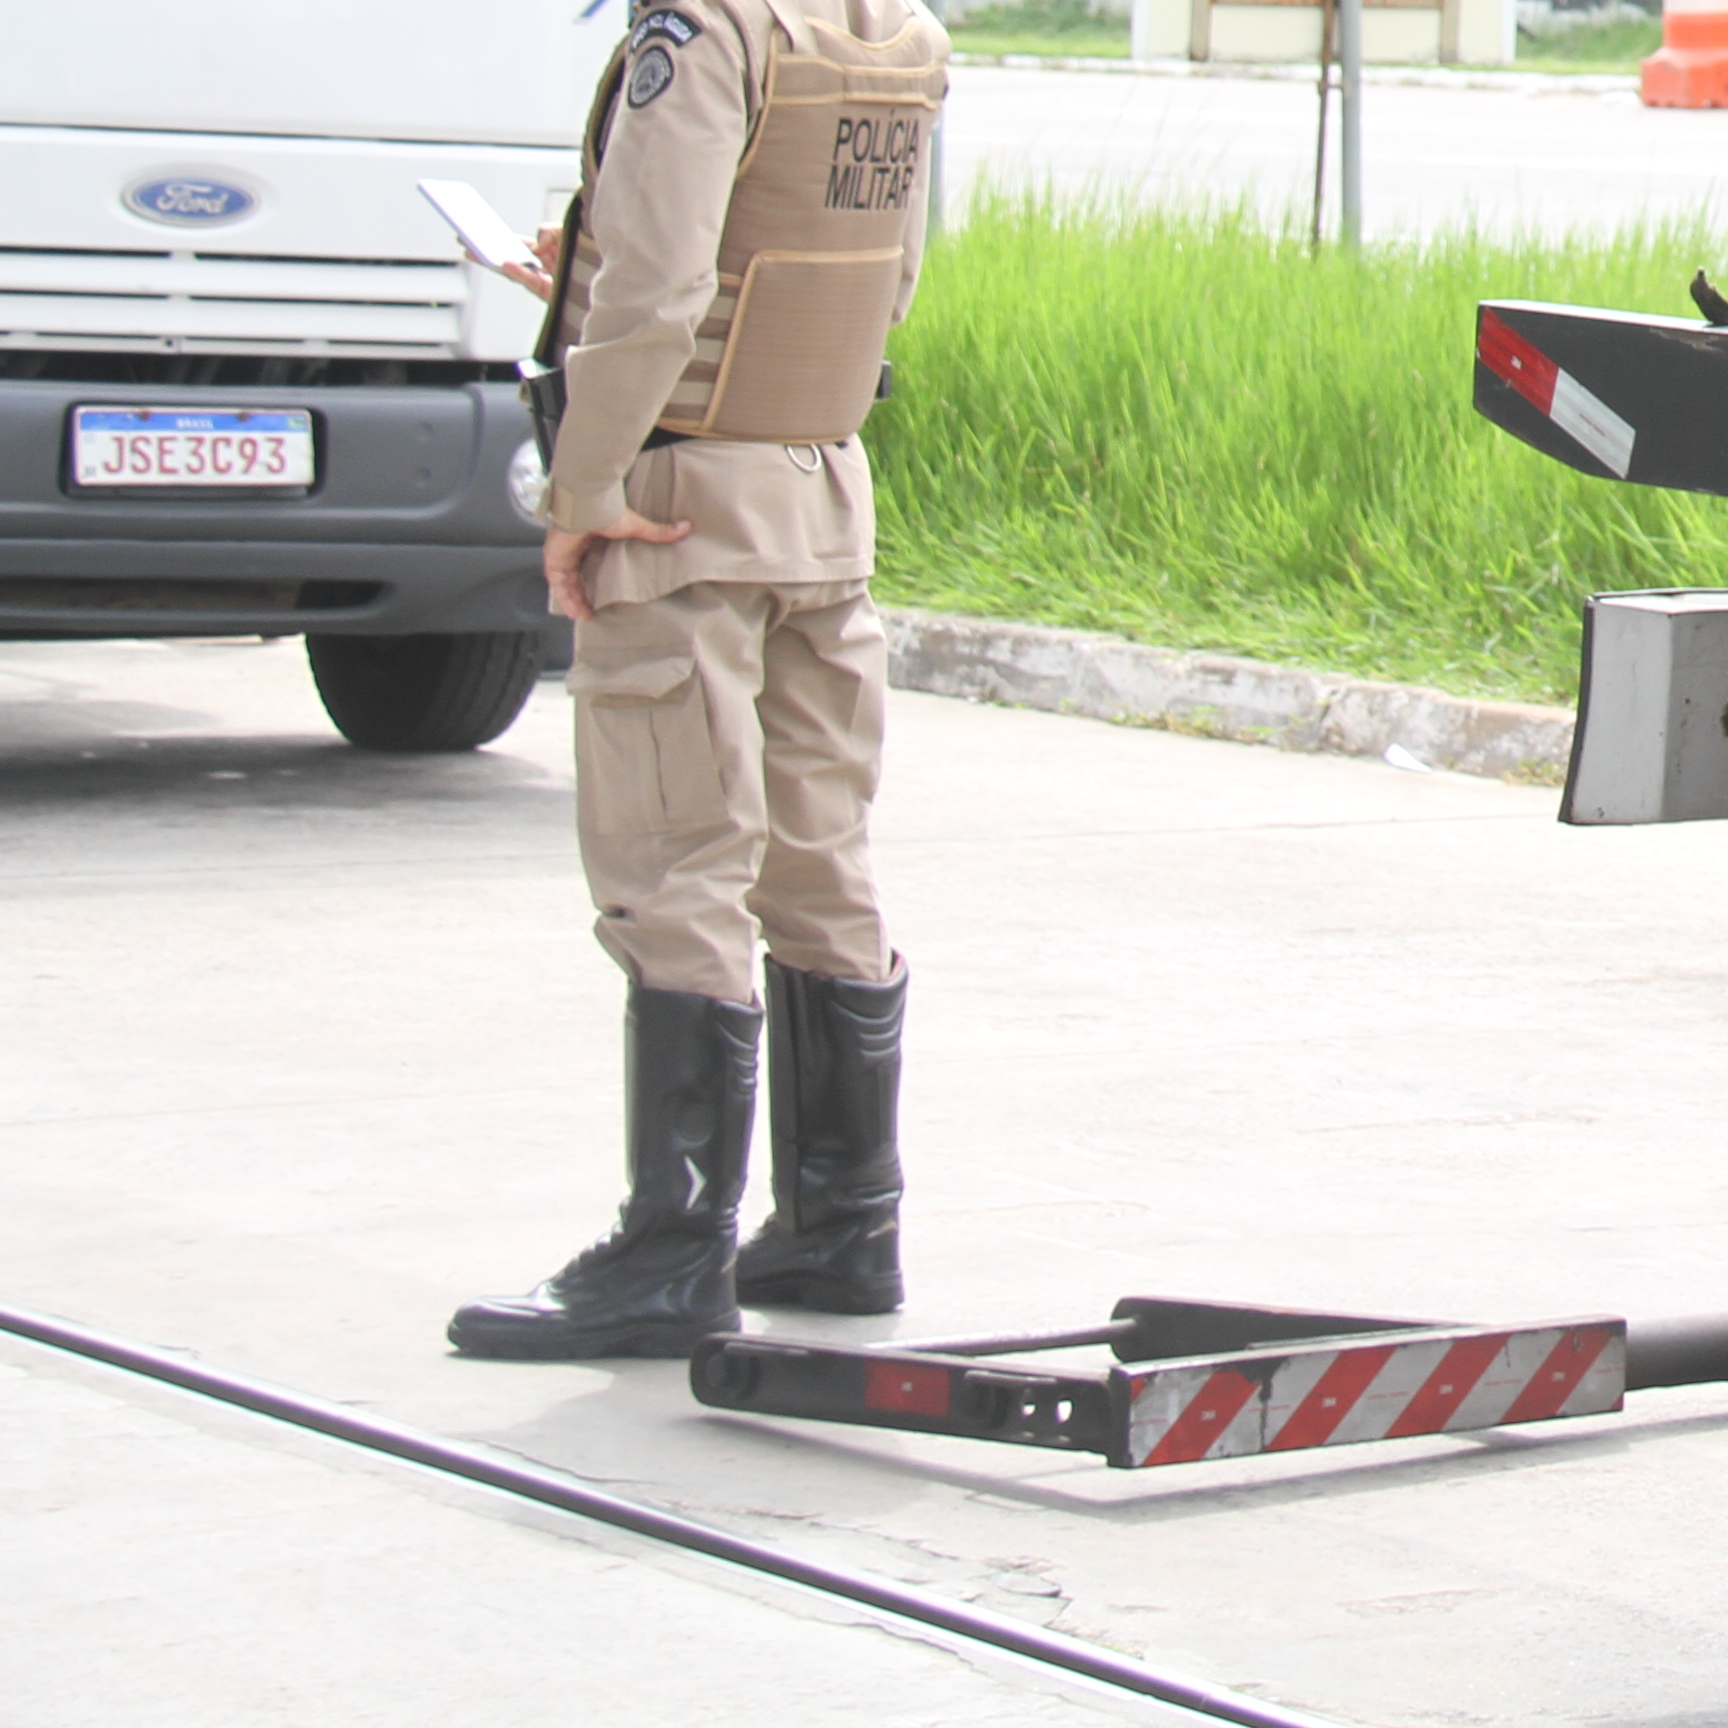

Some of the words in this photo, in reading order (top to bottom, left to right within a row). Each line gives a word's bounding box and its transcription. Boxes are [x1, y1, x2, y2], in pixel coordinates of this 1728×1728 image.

[833, 108, 919, 163] POLÍCIA
[157, 183, 229, 213] Ford
[825, 164, 914, 209] MILITAR
[103, 435, 285, 474] JSE3C93
